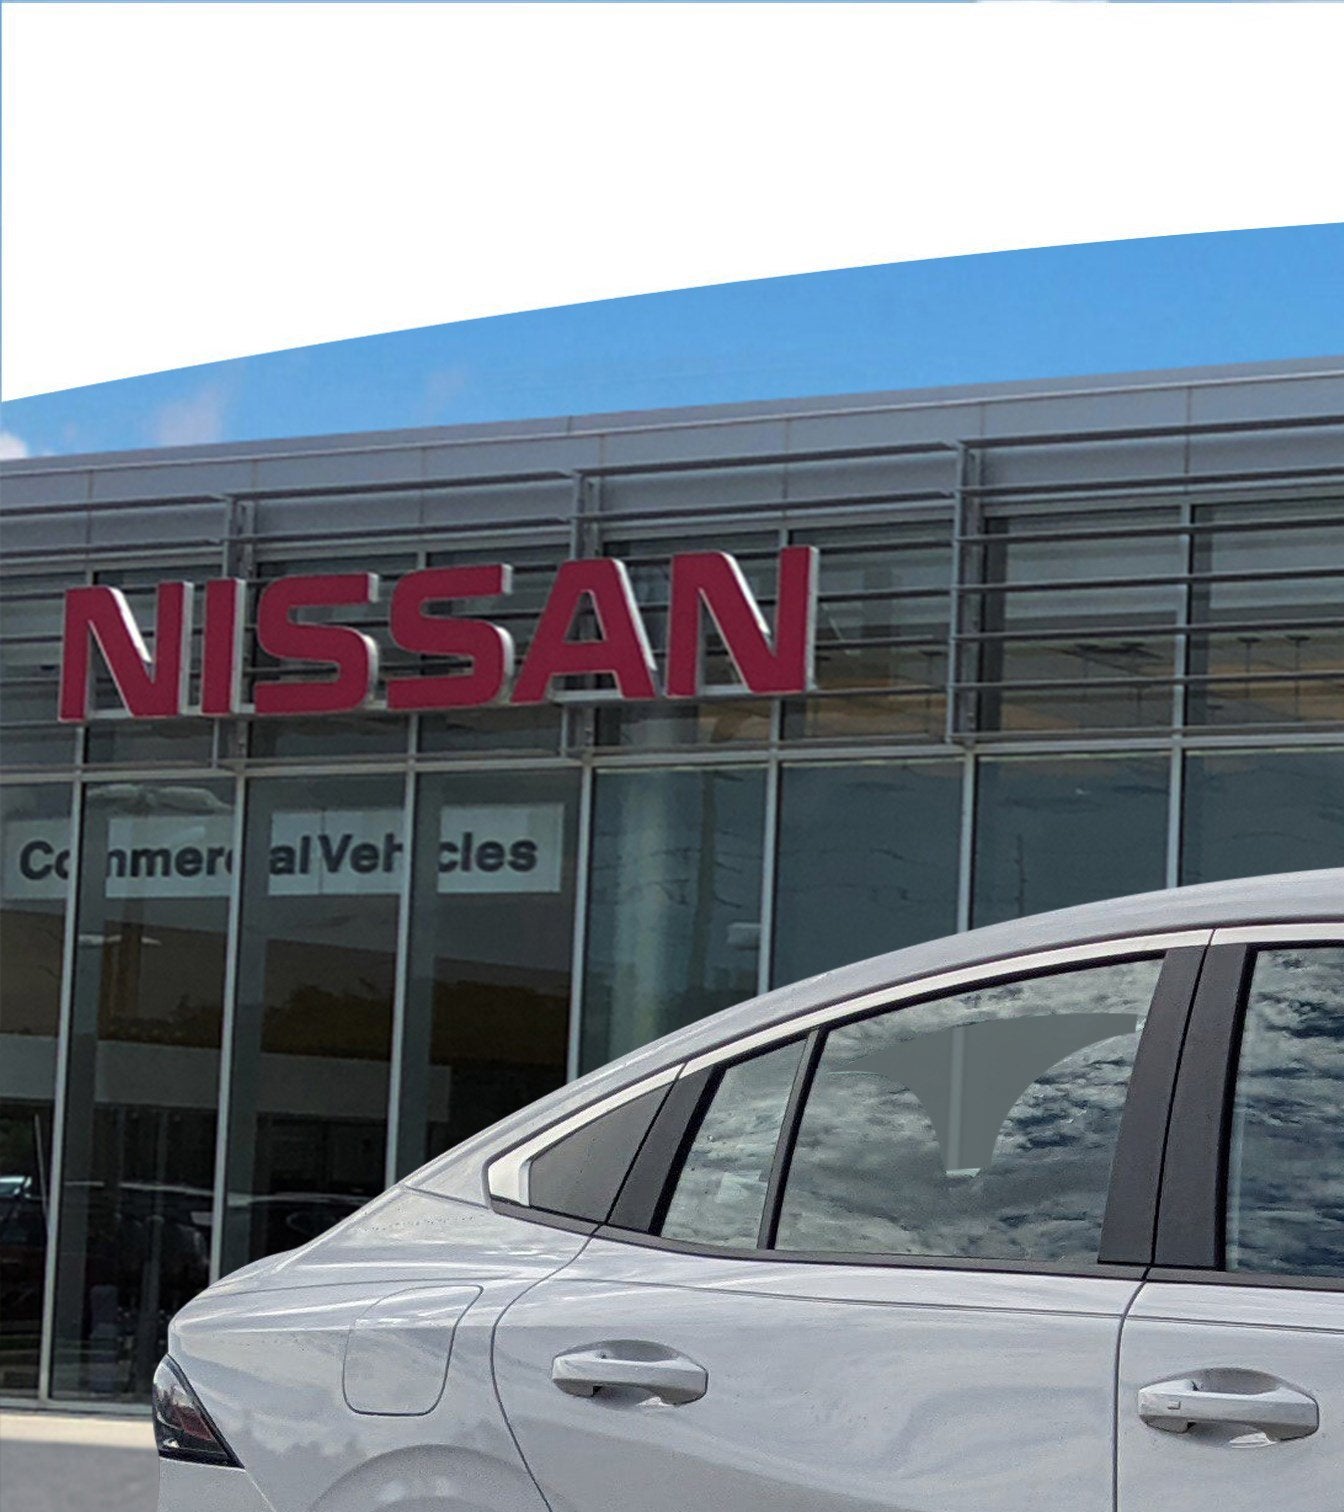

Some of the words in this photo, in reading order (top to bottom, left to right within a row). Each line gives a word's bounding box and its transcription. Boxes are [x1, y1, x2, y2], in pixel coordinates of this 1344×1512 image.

[58, 546, 818, 722] NISSAN
[19, 835, 312, 880] Commeral
[318, 831, 538, 874] Vehcles
